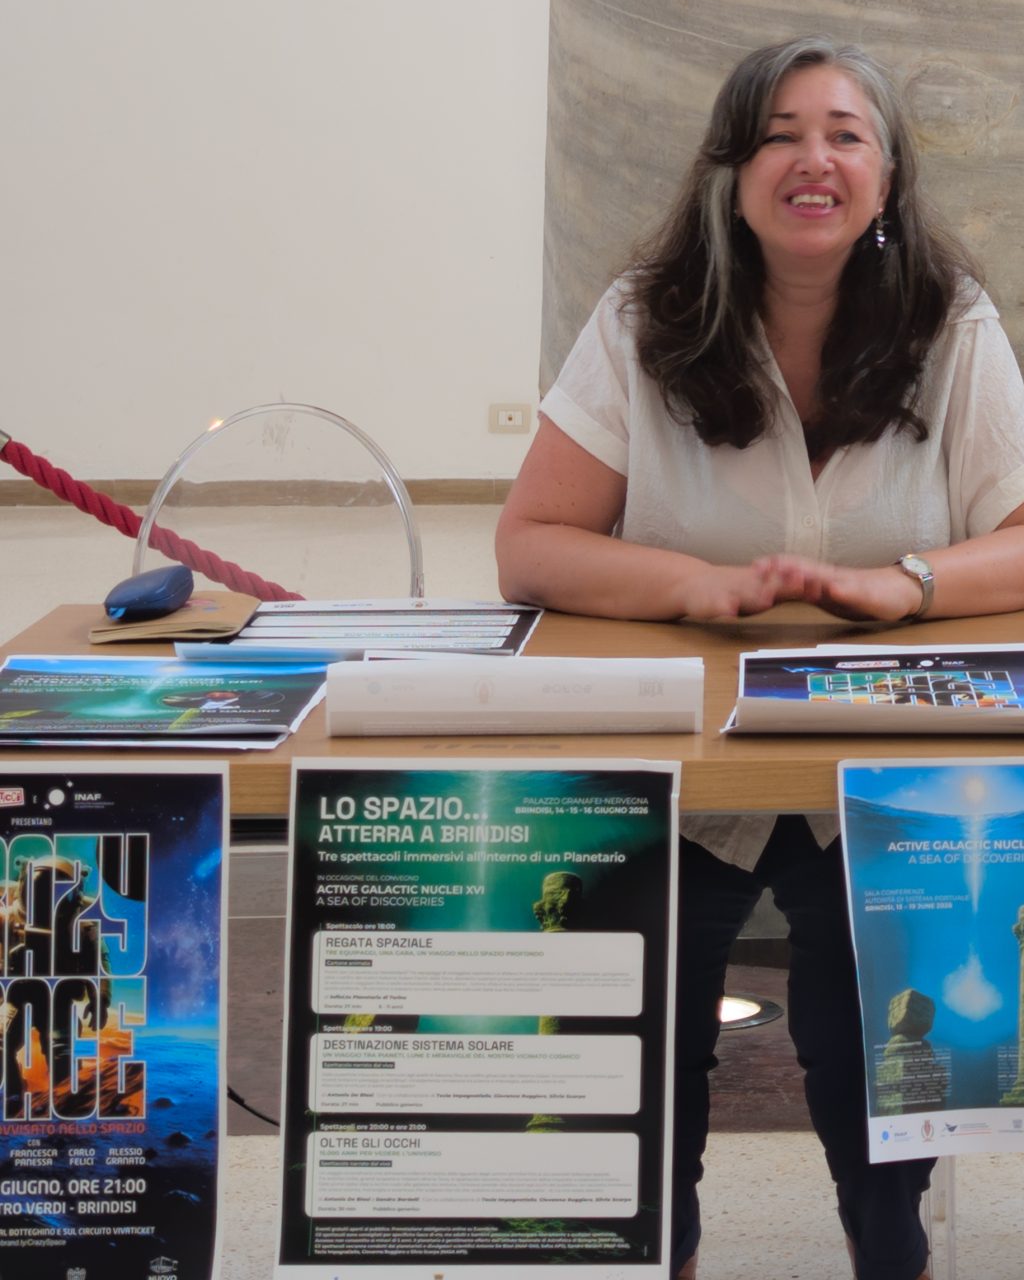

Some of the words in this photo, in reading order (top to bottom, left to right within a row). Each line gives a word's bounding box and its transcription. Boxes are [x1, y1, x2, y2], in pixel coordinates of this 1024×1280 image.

[74, 793, 102, 801] INAF
[523, 797, 561, 805] PALAZZO
[320, 796, 356, 820] LO
[363, 796, 489, 820] SPAZIO...
[515, 806, 554, 815] BRINDISI,
[555, 806, 565, 815] 14
[570, 806, 579, 815] 15
[583, 806, 592, 815] 16
[594, 806, 627, 815] GIUGNO
[628, 806, 649, 815] 2026
[11, 817, 53, 827] PRESENTANO
[318, 825, 415, 843] ATTERRA
[420, 825, 435, 843] A
[440, 825, 529, 843] BRINDISI
[887, 840, 930, 852] ACTIVE
[932, 840, 991, 851] GALACTIC
[318, 850, 338, 862] Tre
[340, 850, 401, 864] spettacoli
[404, 851, 464, 863] immersivi
[467, 851, 527, 863] all'interno
[530, 851, 542, 863] di
[545, 854, 561, 863] un
[564, 851, 626, 863] Planetario
[908, 854, 917, 864] A
[919, 854, 941, 864] SEA
[944, 853, 960, 864] OF
[326, 874, 364, 882] OCCASIONE
[366, 874, 379, 882] DEL
[380, 874, 419, 882] CONVEGNO
[317, 885, 358, 894] ACTIVE
[361, 885, 418, 895] GALACTIC
[421, 885, 463, 895] NUCLEI
[466, 885, 485, 895] XVI
[0, 833, 150, 978] AZY
[316, 896, 325, 906] A
[327, 896, 349, 907] SEA
[351, 896, 367, 907] OF
[370, 897, 445, 907] DISCOVERIES
[326, 937, 373, 948] REGATA
[376, 937, 433, 948] SPAZIALE
[0, 975, 147, 1121] ACE
[324, 1040, 408, 1050] DESTINAZIONE
[412, 1040, 465, 1051] SISTEMA
[468, 1041, 514, 1051] SOLARE
[59, 1123, 97, 1135] NELLO
[101, 1122, 146, 1134] SPAZIO
[27, 1138, 41, 1147] CON
[320, 1137, 358, 1148] OLTRE
[362, 1137, 380, 1148] GLI
[384, 1137, 421, 1148] OCCHI
[10, 1149, 58, 1158] FRANCESCA
[68, 1148, 96, 1157] CARLO
[109, 1147, 144, 1156] ALESSIO
[15, 1158, 53, 1166] PANESSA
[69, 1157, 94, 1166] FELICI
[106, 1156, 146, 1166] GRANATO
[1, 1179, 65, 1196] GIUGNO,
[68, 1178, 100, 1194] ORE
[104, 1178, 146, 1194] 21:00
[26, 1202, 66, 1214] VERDI
[78, 1201, 136, 1214] BRINDISI
[9, 1228, 55, 1237] BOTTEGHINO
[56, 1228, 61, 1236] E
[63, 1227, 77, 1236] SUL
[79, 1227, 111, 1235] CIRCUITO
[113, 1226, 156, 1235] VIVATICKET
